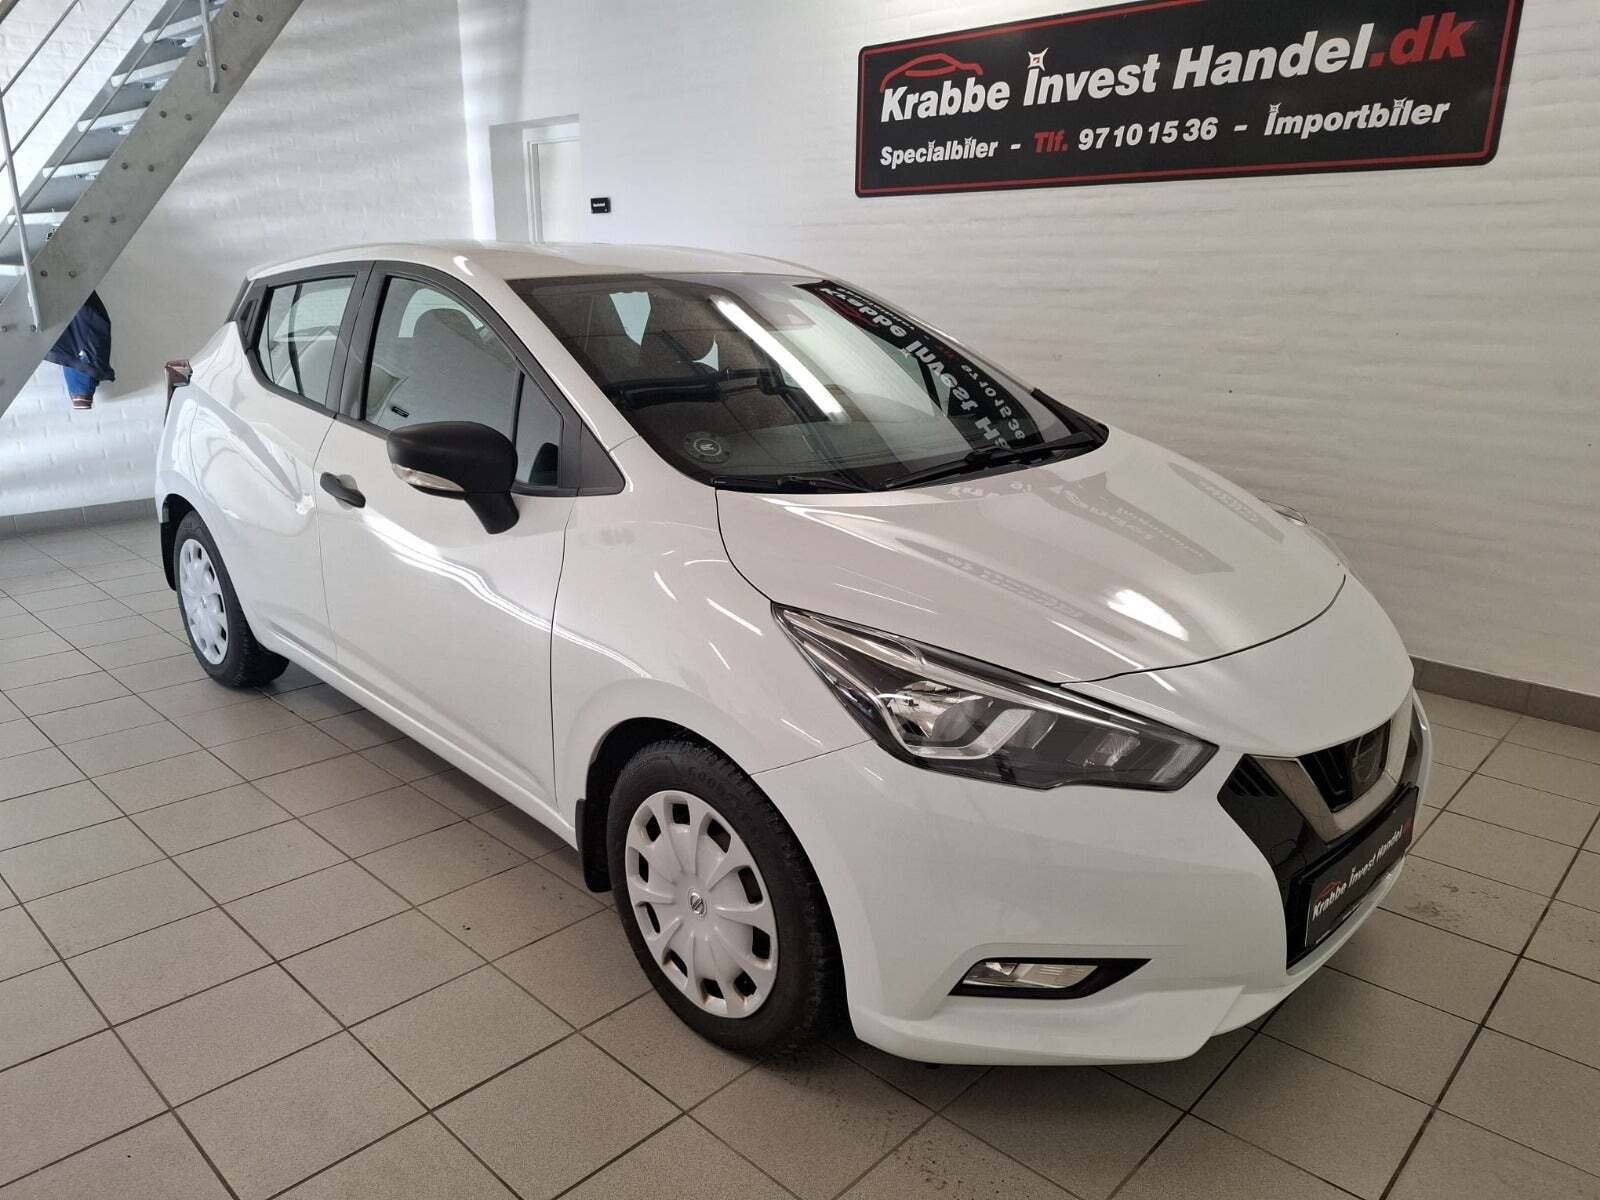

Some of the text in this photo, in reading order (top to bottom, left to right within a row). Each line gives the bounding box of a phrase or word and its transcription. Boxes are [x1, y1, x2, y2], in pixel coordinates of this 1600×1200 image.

[881, 11, 1476, 122] Krabbe Invest Handel.dk
[880, 136, 998, 169] Specialbiler
[1034, 129, 1069, 153] Tlf.
[1264, 97, 1451, 139] Importbiler
